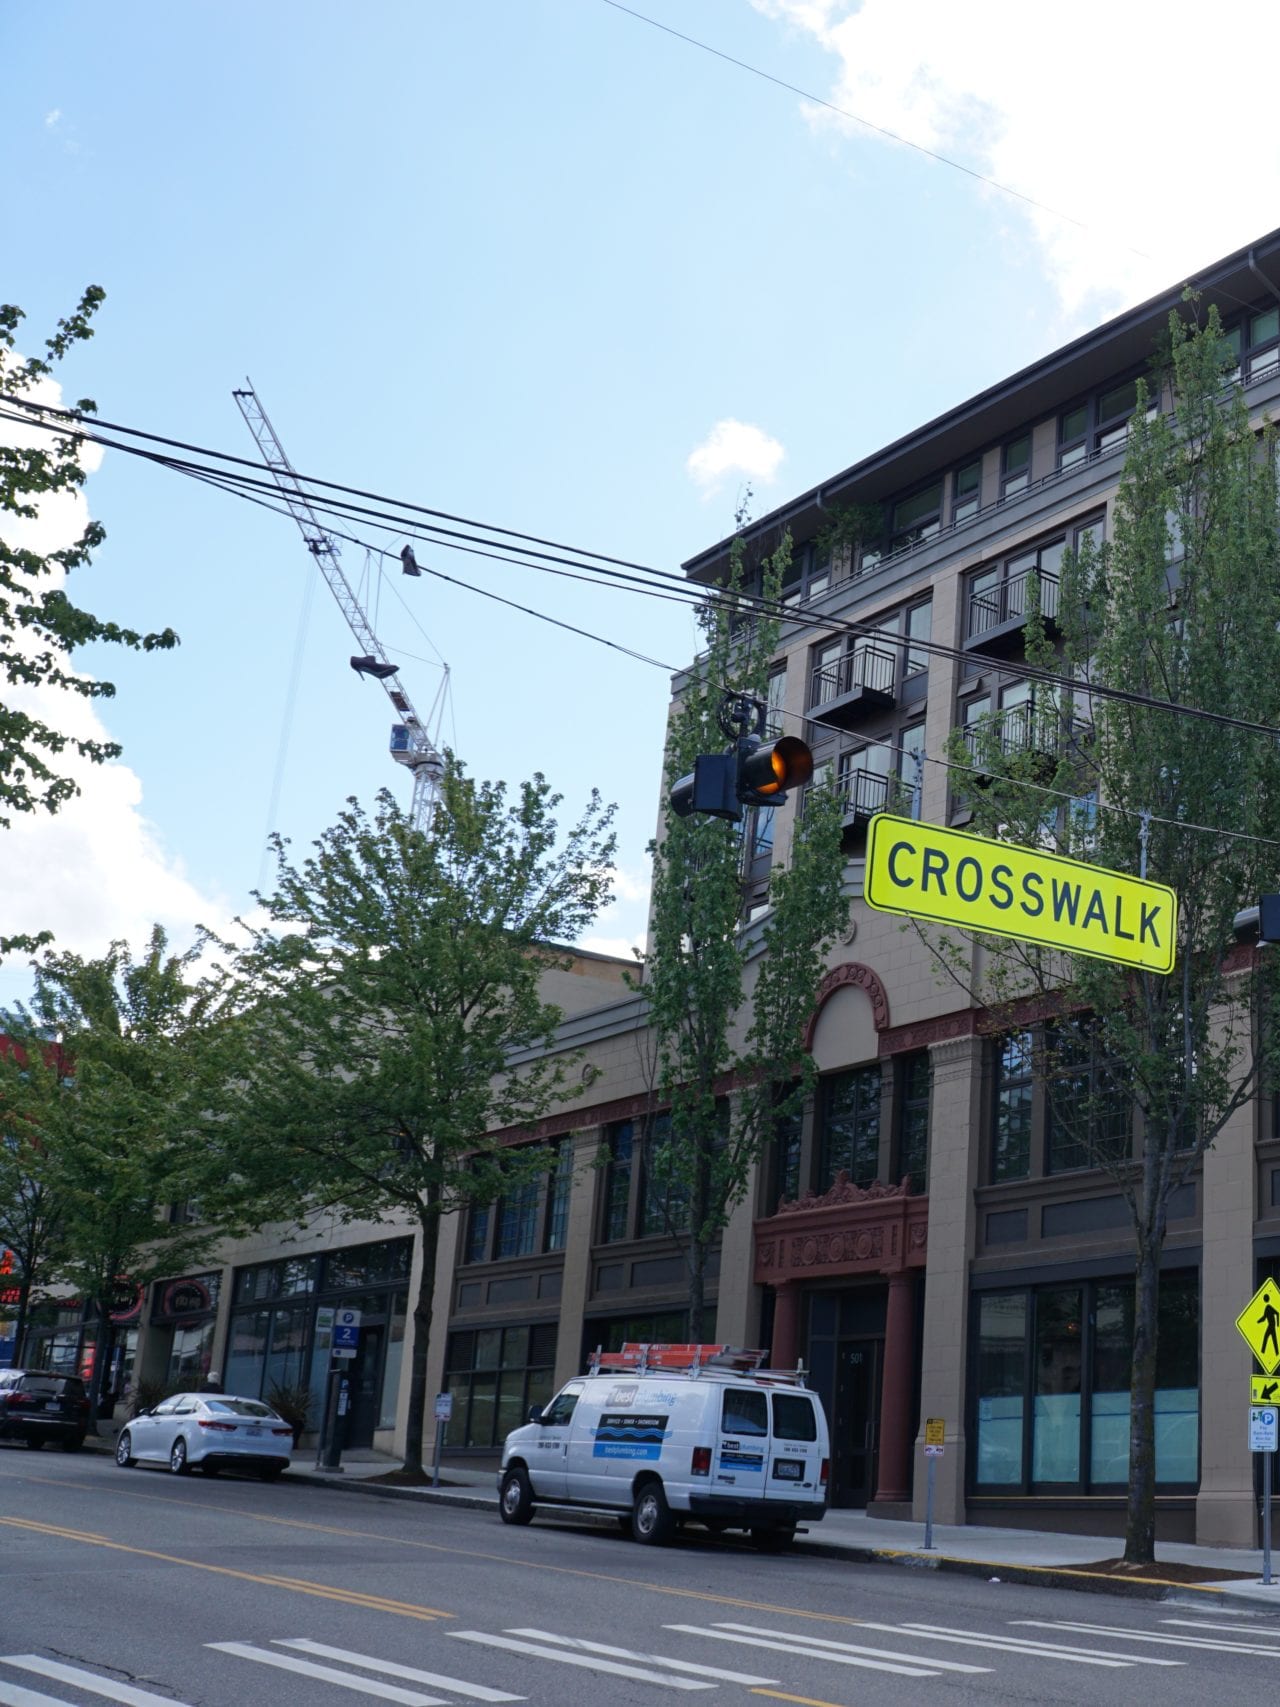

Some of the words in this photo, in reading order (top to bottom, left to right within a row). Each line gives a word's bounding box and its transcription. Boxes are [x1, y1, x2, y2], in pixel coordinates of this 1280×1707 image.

[888, 841, 1162, 948] CROSSWALK
[342, 1328, 351, 1339] 2
[614, 1388, 636, 1403] best
[1264, 1414, 1272, 1424] P
